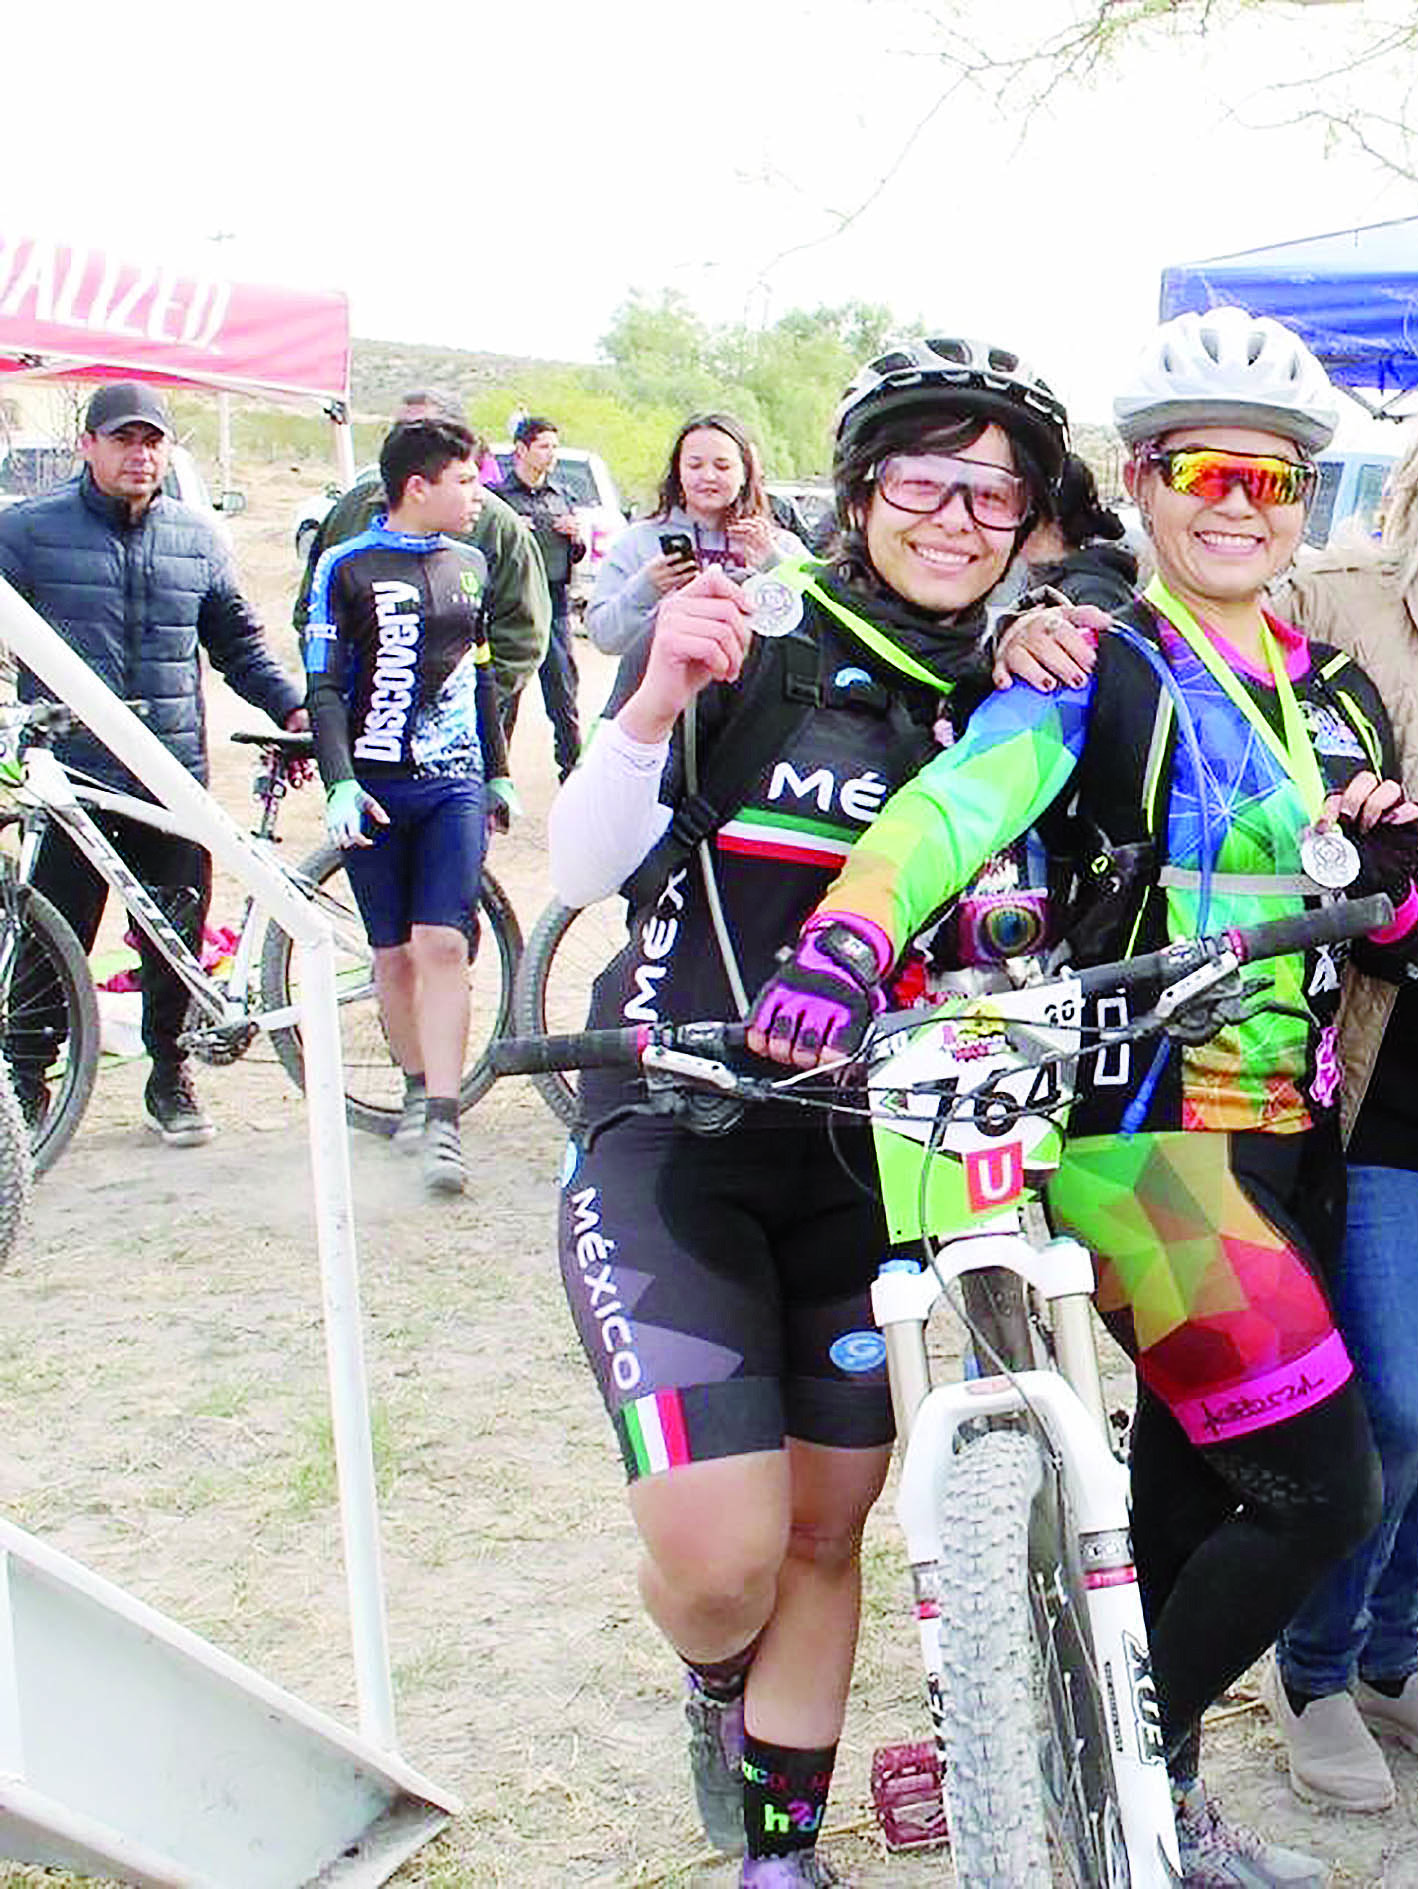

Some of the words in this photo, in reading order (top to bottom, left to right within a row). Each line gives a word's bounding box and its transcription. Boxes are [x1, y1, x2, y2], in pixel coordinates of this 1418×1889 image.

[912, 1061, 1061, 1148] 764
[977, 1152, 1013, 1200] U
[570, 1186, 642, 1391] MÉXICO
